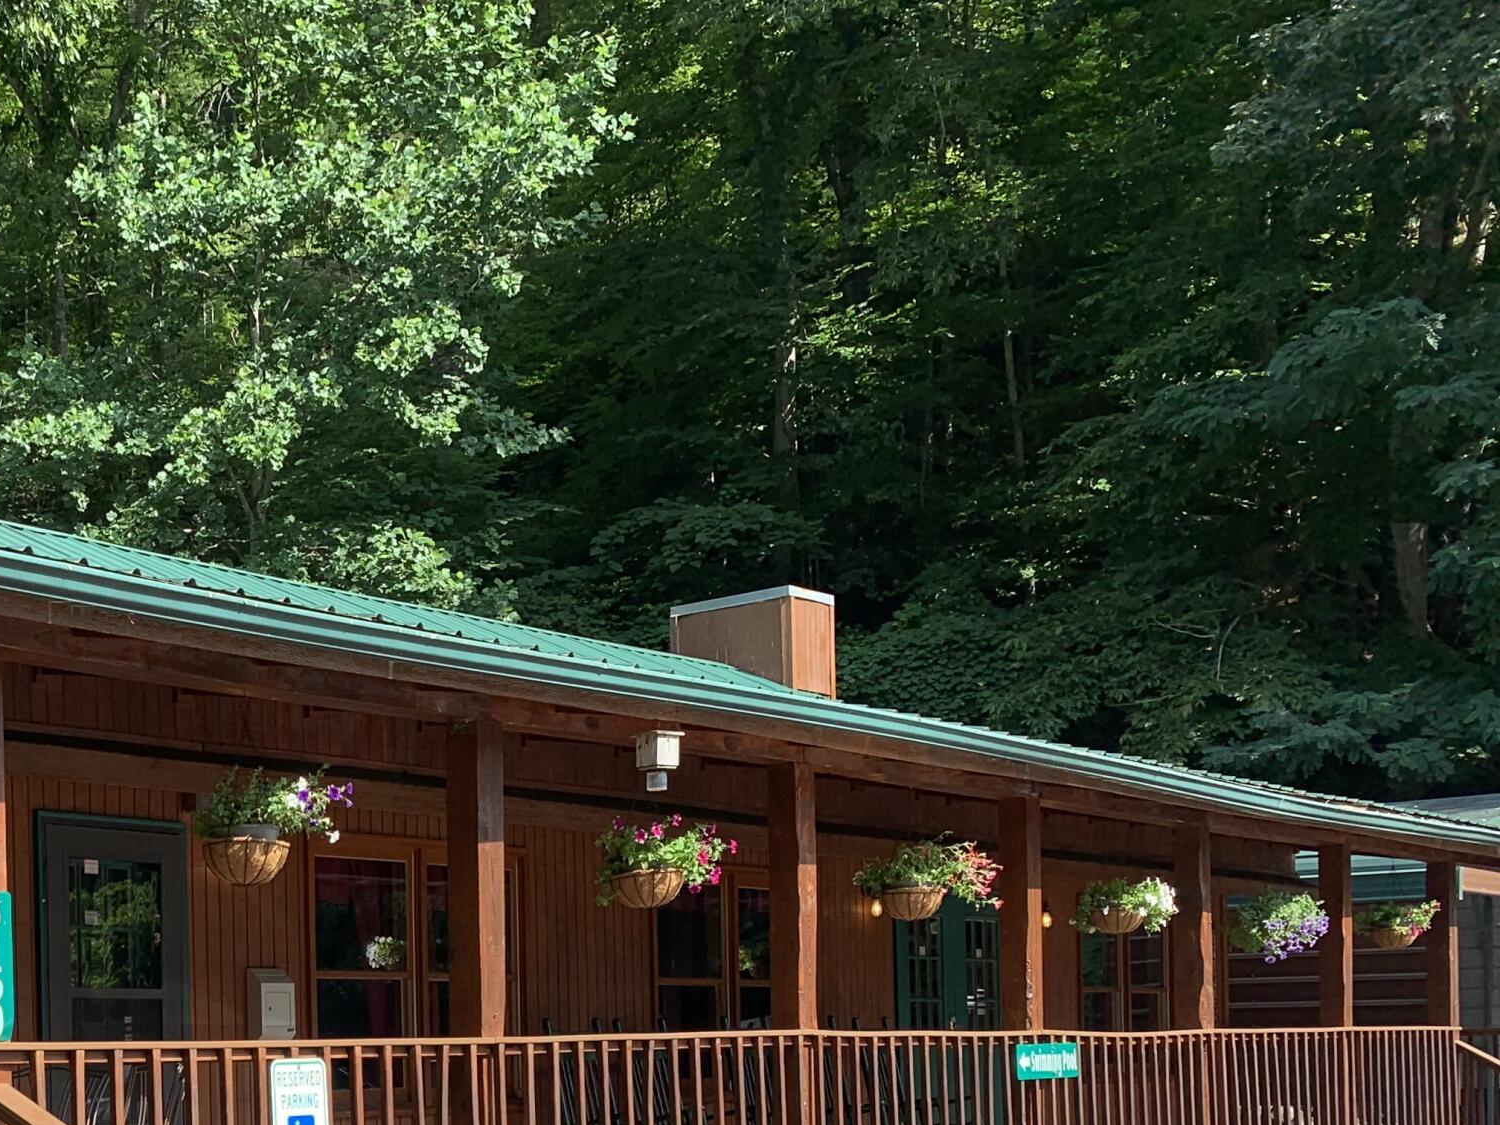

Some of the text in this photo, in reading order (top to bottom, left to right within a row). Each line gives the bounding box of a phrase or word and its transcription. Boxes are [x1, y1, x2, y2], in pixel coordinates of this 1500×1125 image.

[1031, 1048, 1062, 1077] Swimming
[276, 1070, 321, 1087] RESERVED
[281, 1093, 319, 1109] PARKING
